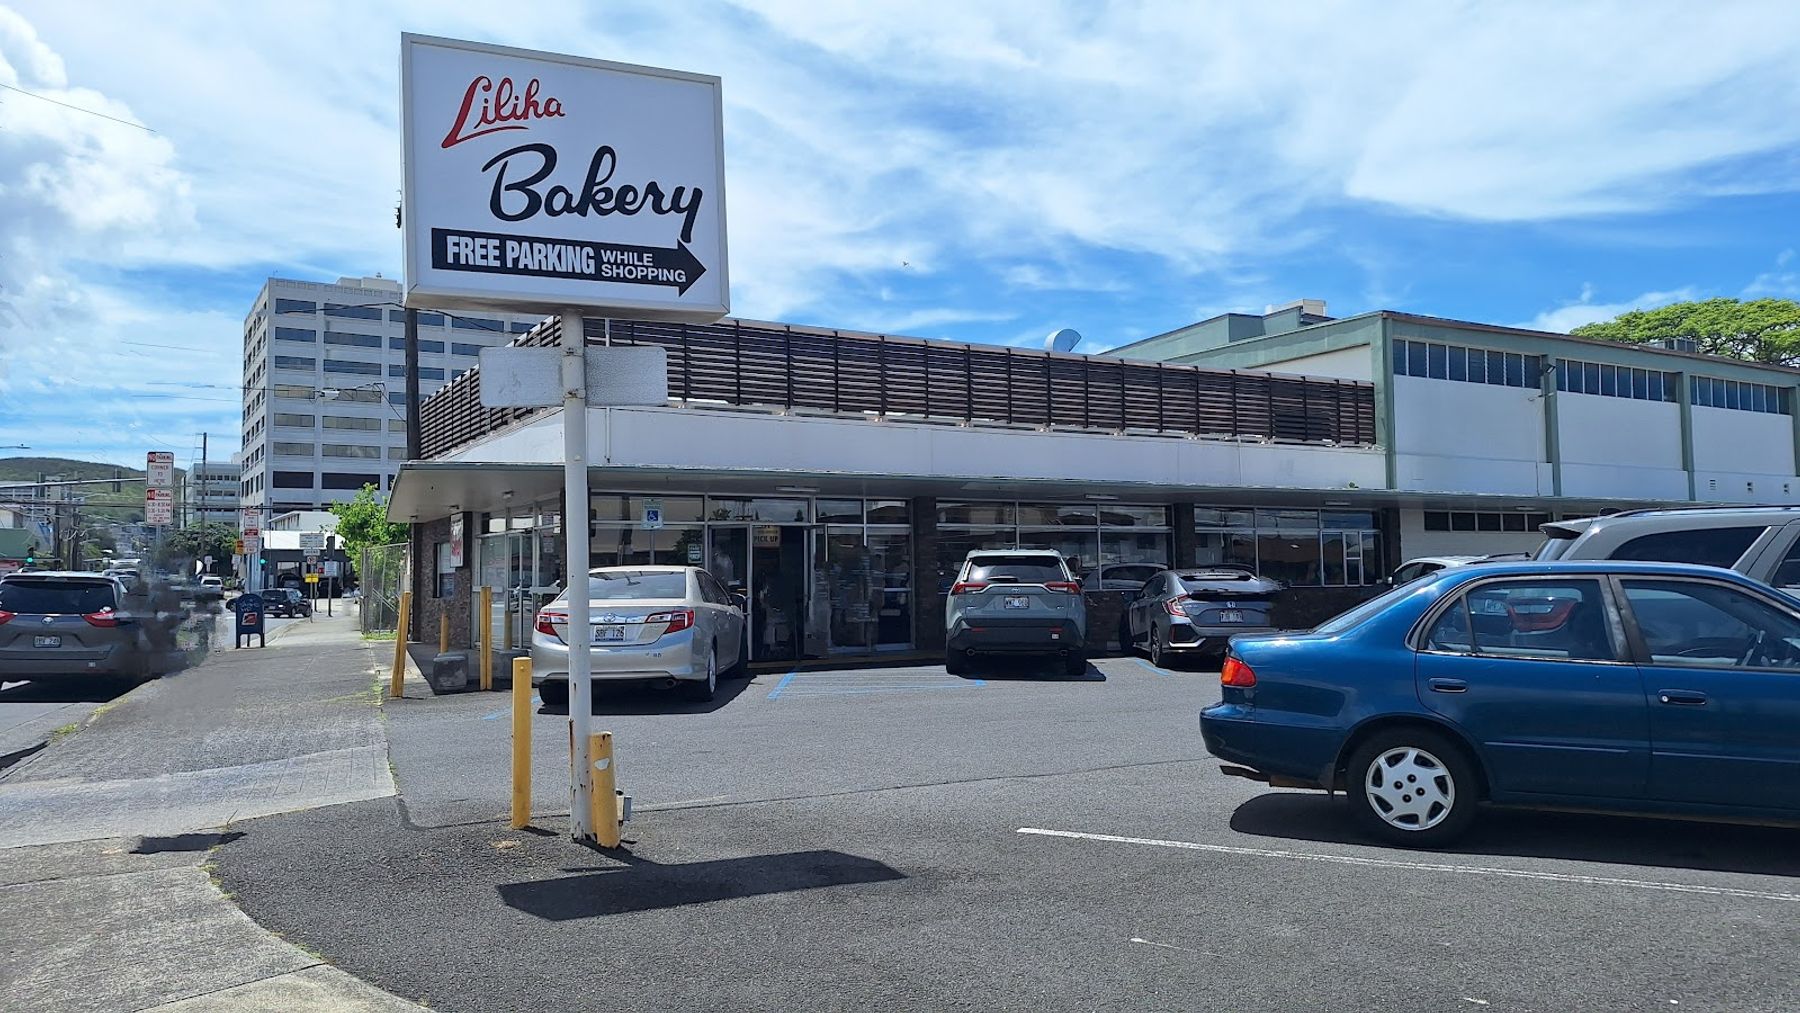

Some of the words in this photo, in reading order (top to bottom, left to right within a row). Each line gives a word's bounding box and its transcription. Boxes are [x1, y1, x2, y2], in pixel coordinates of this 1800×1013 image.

[441, 76, 565, 148] Liliha
[481, 143, 703, 243] Bakery
[446, 235, 500, 267] FREE
[506, 240, 595, 275] PARKING
[601, 249, 653, 267] WHILE
[601, 264, 687, 283] SHOPPING
